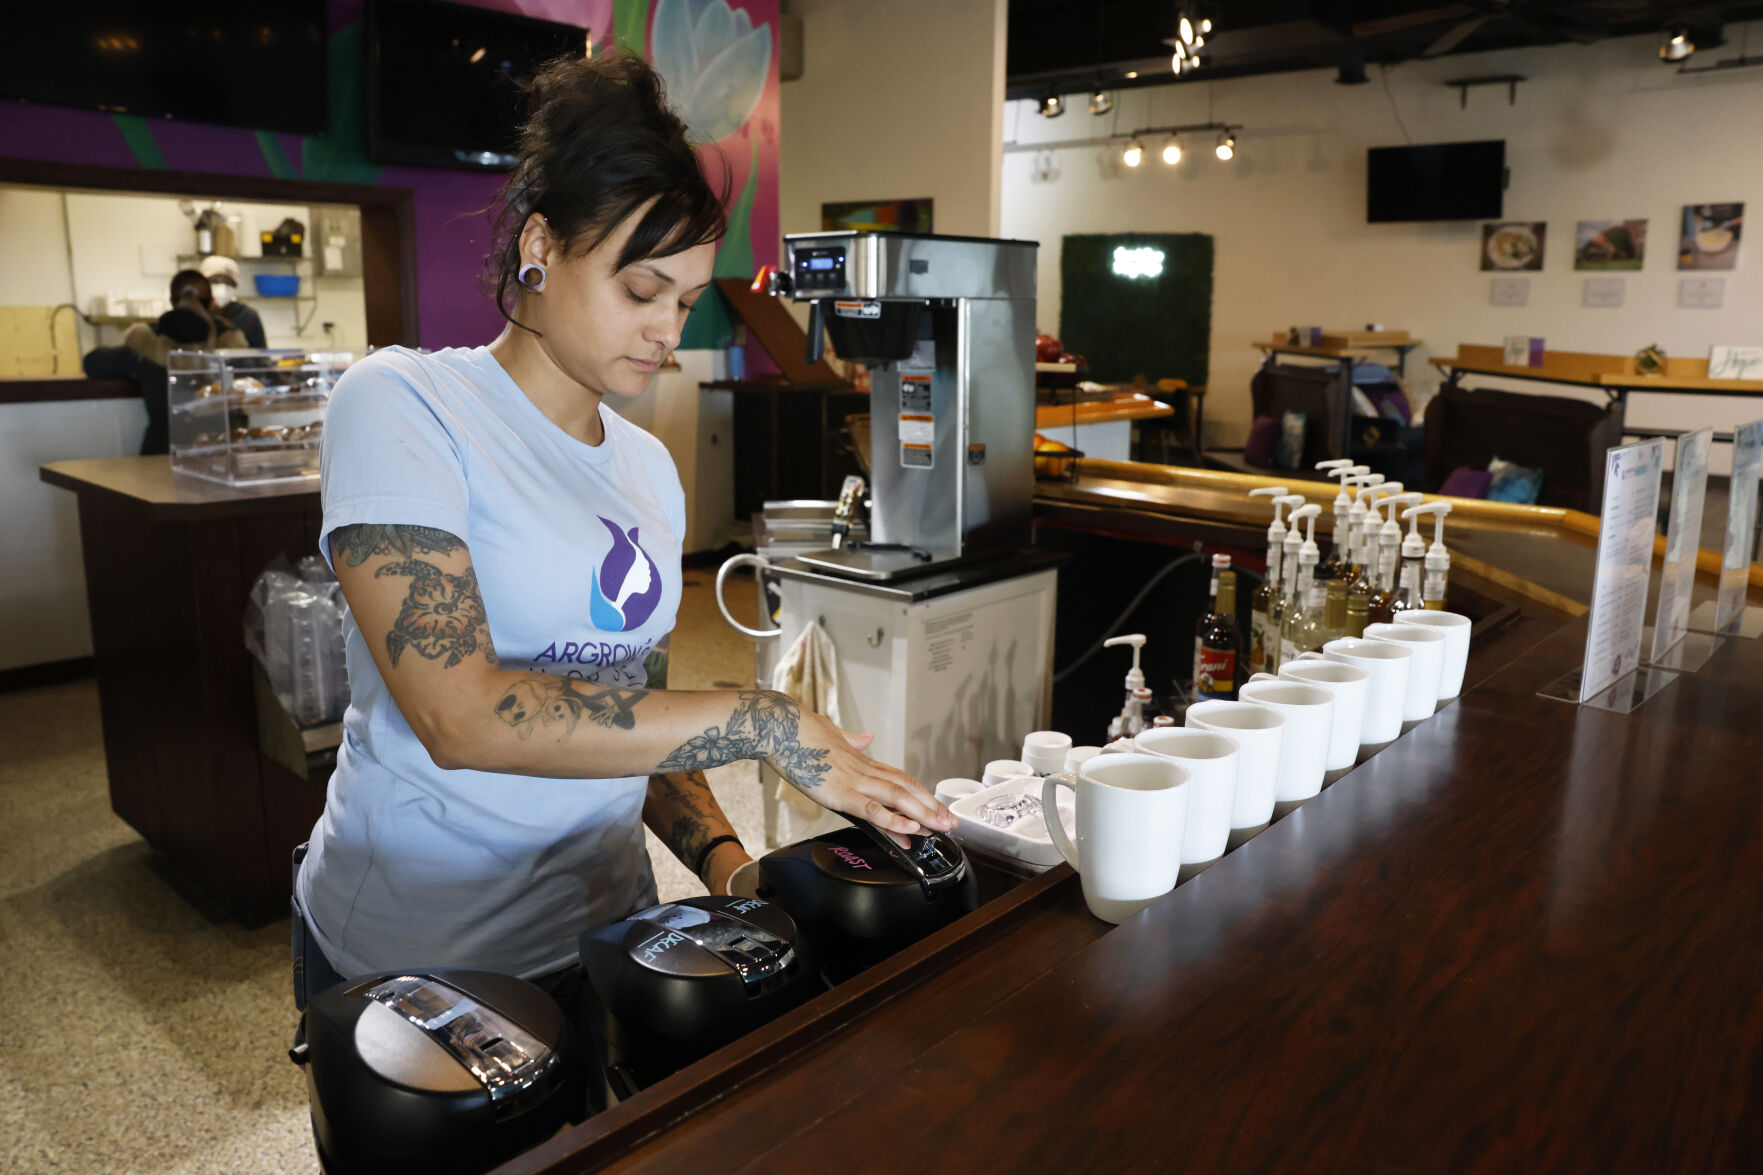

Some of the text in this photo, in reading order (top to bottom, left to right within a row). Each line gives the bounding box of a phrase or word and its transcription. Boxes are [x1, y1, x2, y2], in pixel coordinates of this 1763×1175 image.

[1200, 655, 1228, 673] rani
[828, 847, 872, 869] ROAST
[645, 932, 684, 962] DECAF
